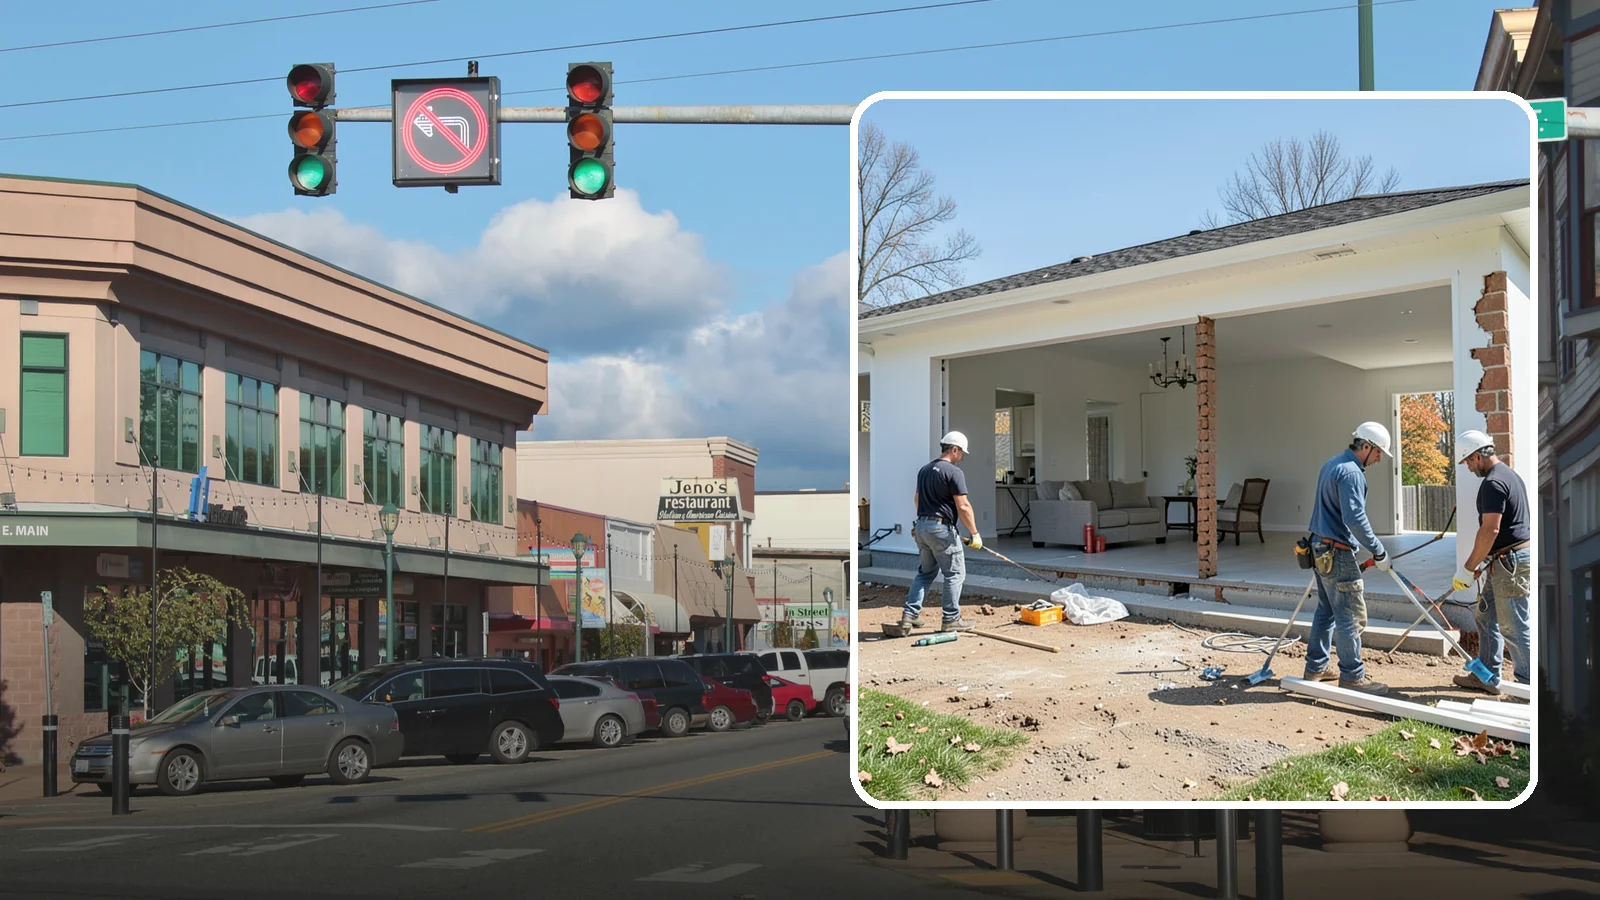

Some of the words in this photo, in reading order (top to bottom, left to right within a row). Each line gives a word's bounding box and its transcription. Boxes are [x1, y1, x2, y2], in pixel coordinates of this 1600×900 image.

[669, 480, 727, 494] Jeno's
[665, 497, 731, 509] restaurant
[659, 510, 681, 519] Italian
[686, 510, 714, 519] American
[715, 510, 737, 519] Cuisine
[2, 525, 13, 536] E.
[15, 525, 49, 536] MAIN
[797, 608, 828, 616] Street
